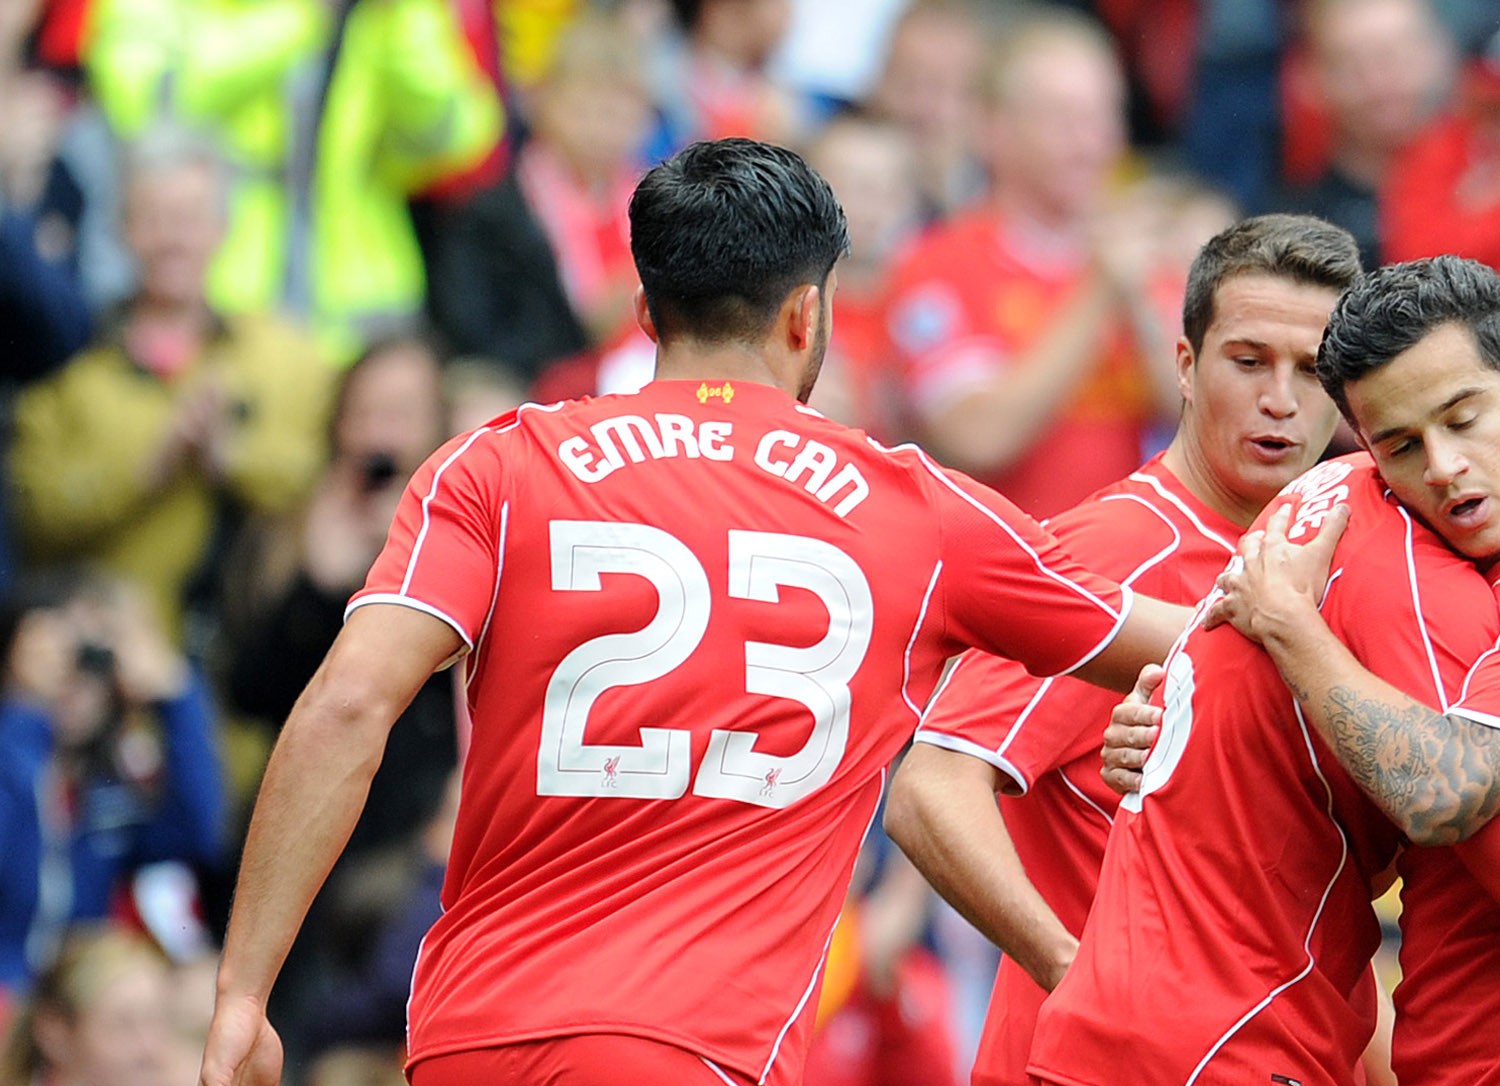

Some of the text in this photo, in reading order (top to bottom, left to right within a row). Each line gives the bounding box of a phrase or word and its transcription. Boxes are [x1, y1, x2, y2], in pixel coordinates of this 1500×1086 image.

[558, 414, 870, 518] EMRE CAN
[537, 520, 874, 809] 23
